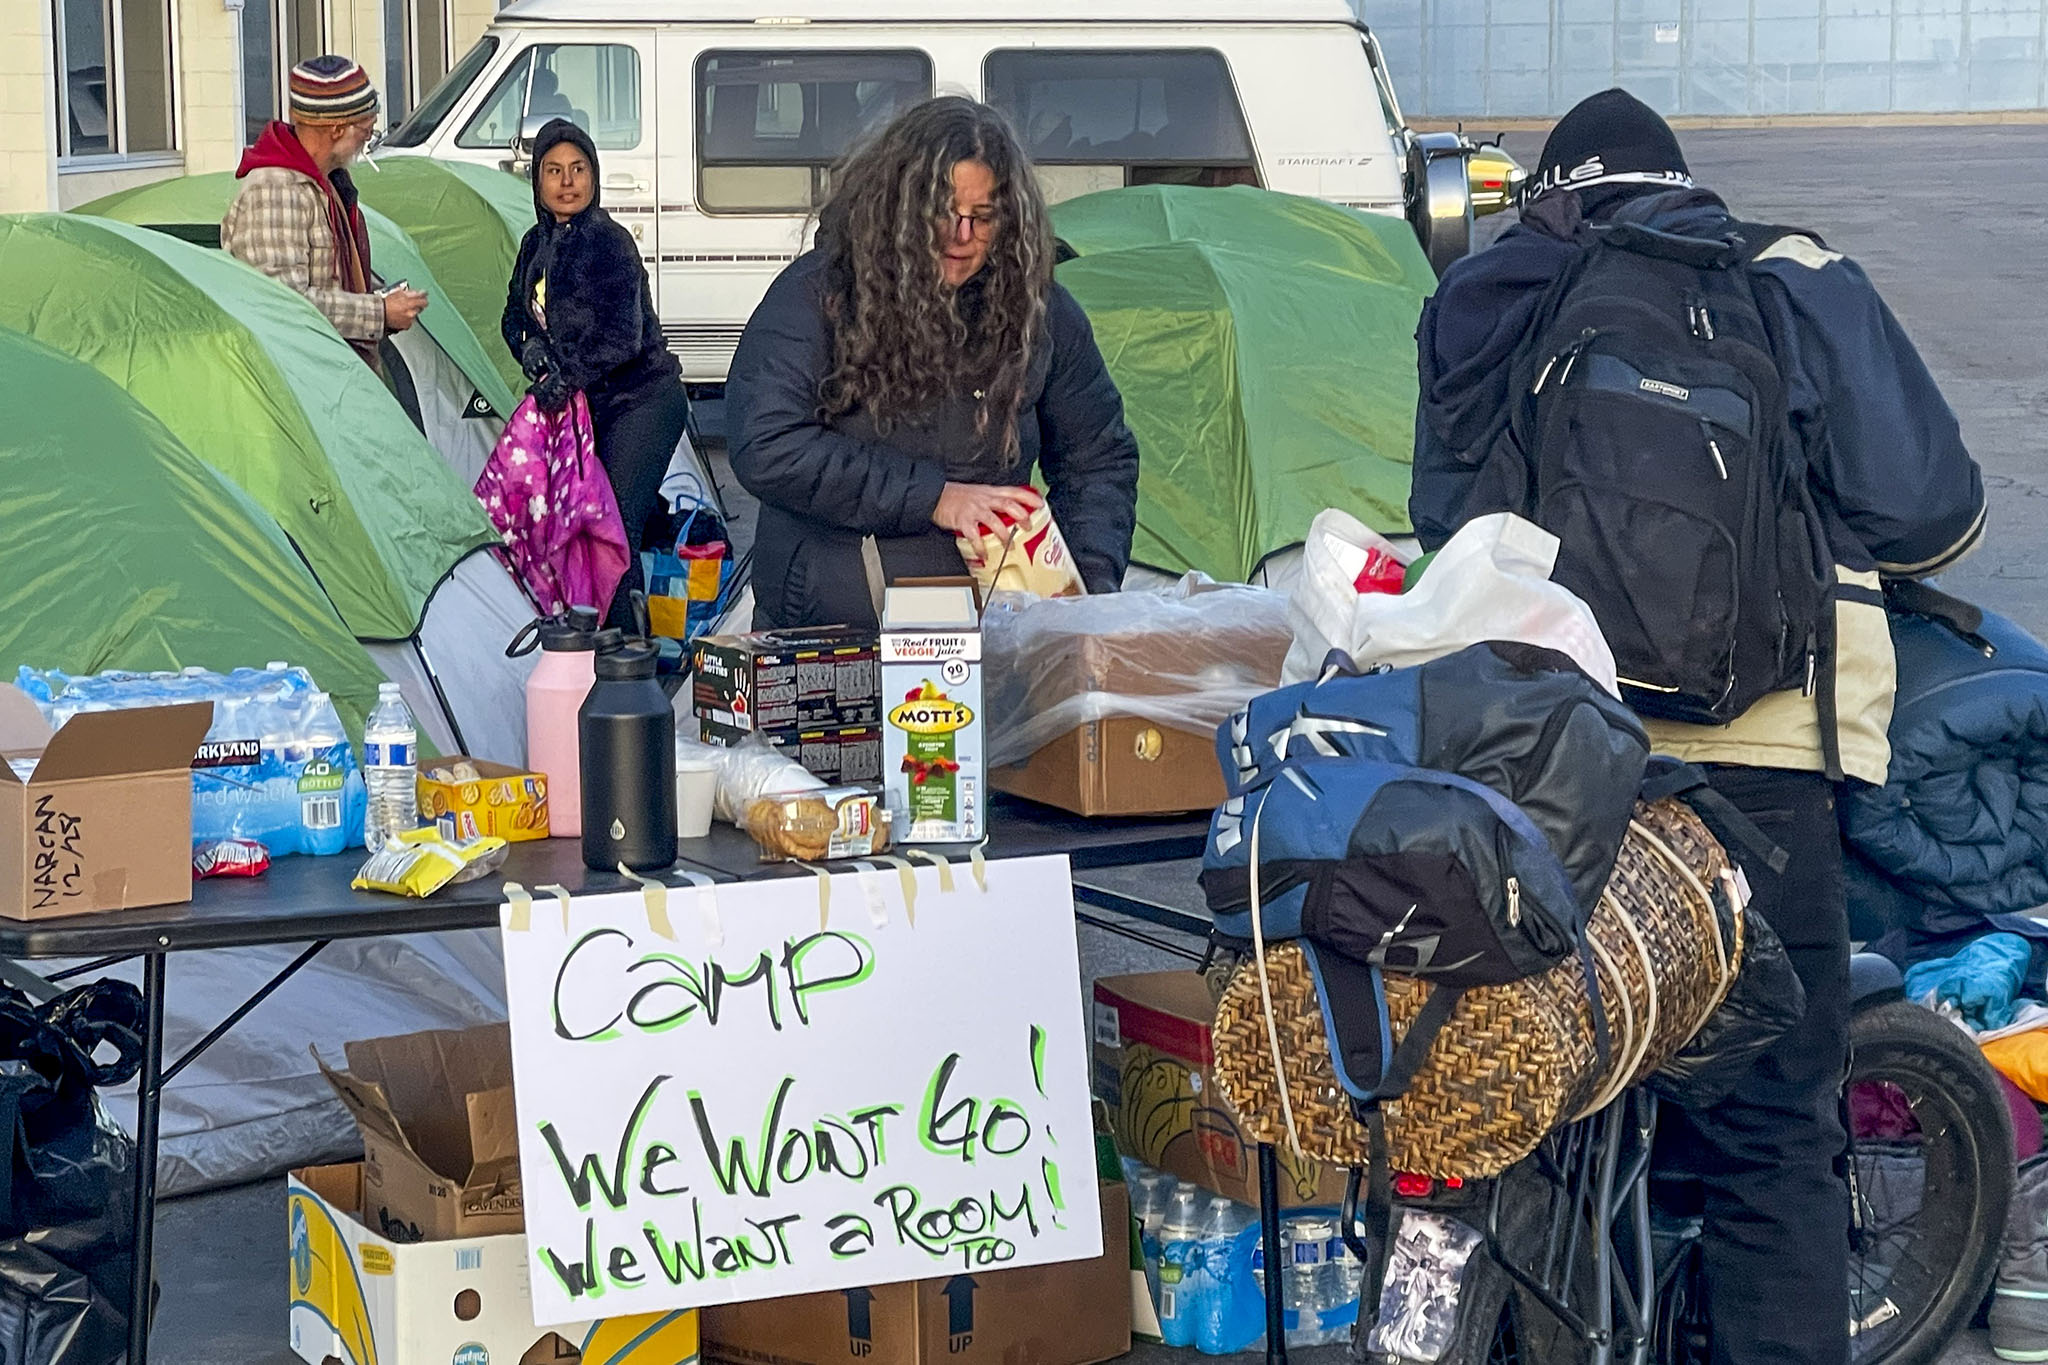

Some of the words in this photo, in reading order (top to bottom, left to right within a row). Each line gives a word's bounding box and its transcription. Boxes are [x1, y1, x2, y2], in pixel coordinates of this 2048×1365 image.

[1277, 157, 1355, 166] STARCRAFT
[902, 637, 928, 647] Real
[929, 637, 959, 646] FRUIT
[894, 647, 935, 656] VEGGIE
[947, 663, 963, 676] 90
[304, 763, 330, 776] 40
[301, 777, 343, 790] BOTTLES
[32, 794, 59, 909] NARCAN
[536, 1074, 689, 1212] We
[536, 1217, 647, 1302] We
[824, 1211, 874, 1260] a
[950, 1235, 1016, 1270] TOO
[849, 1339, 872, 1358] UP
[949, 1335, 973, 1354] UP
